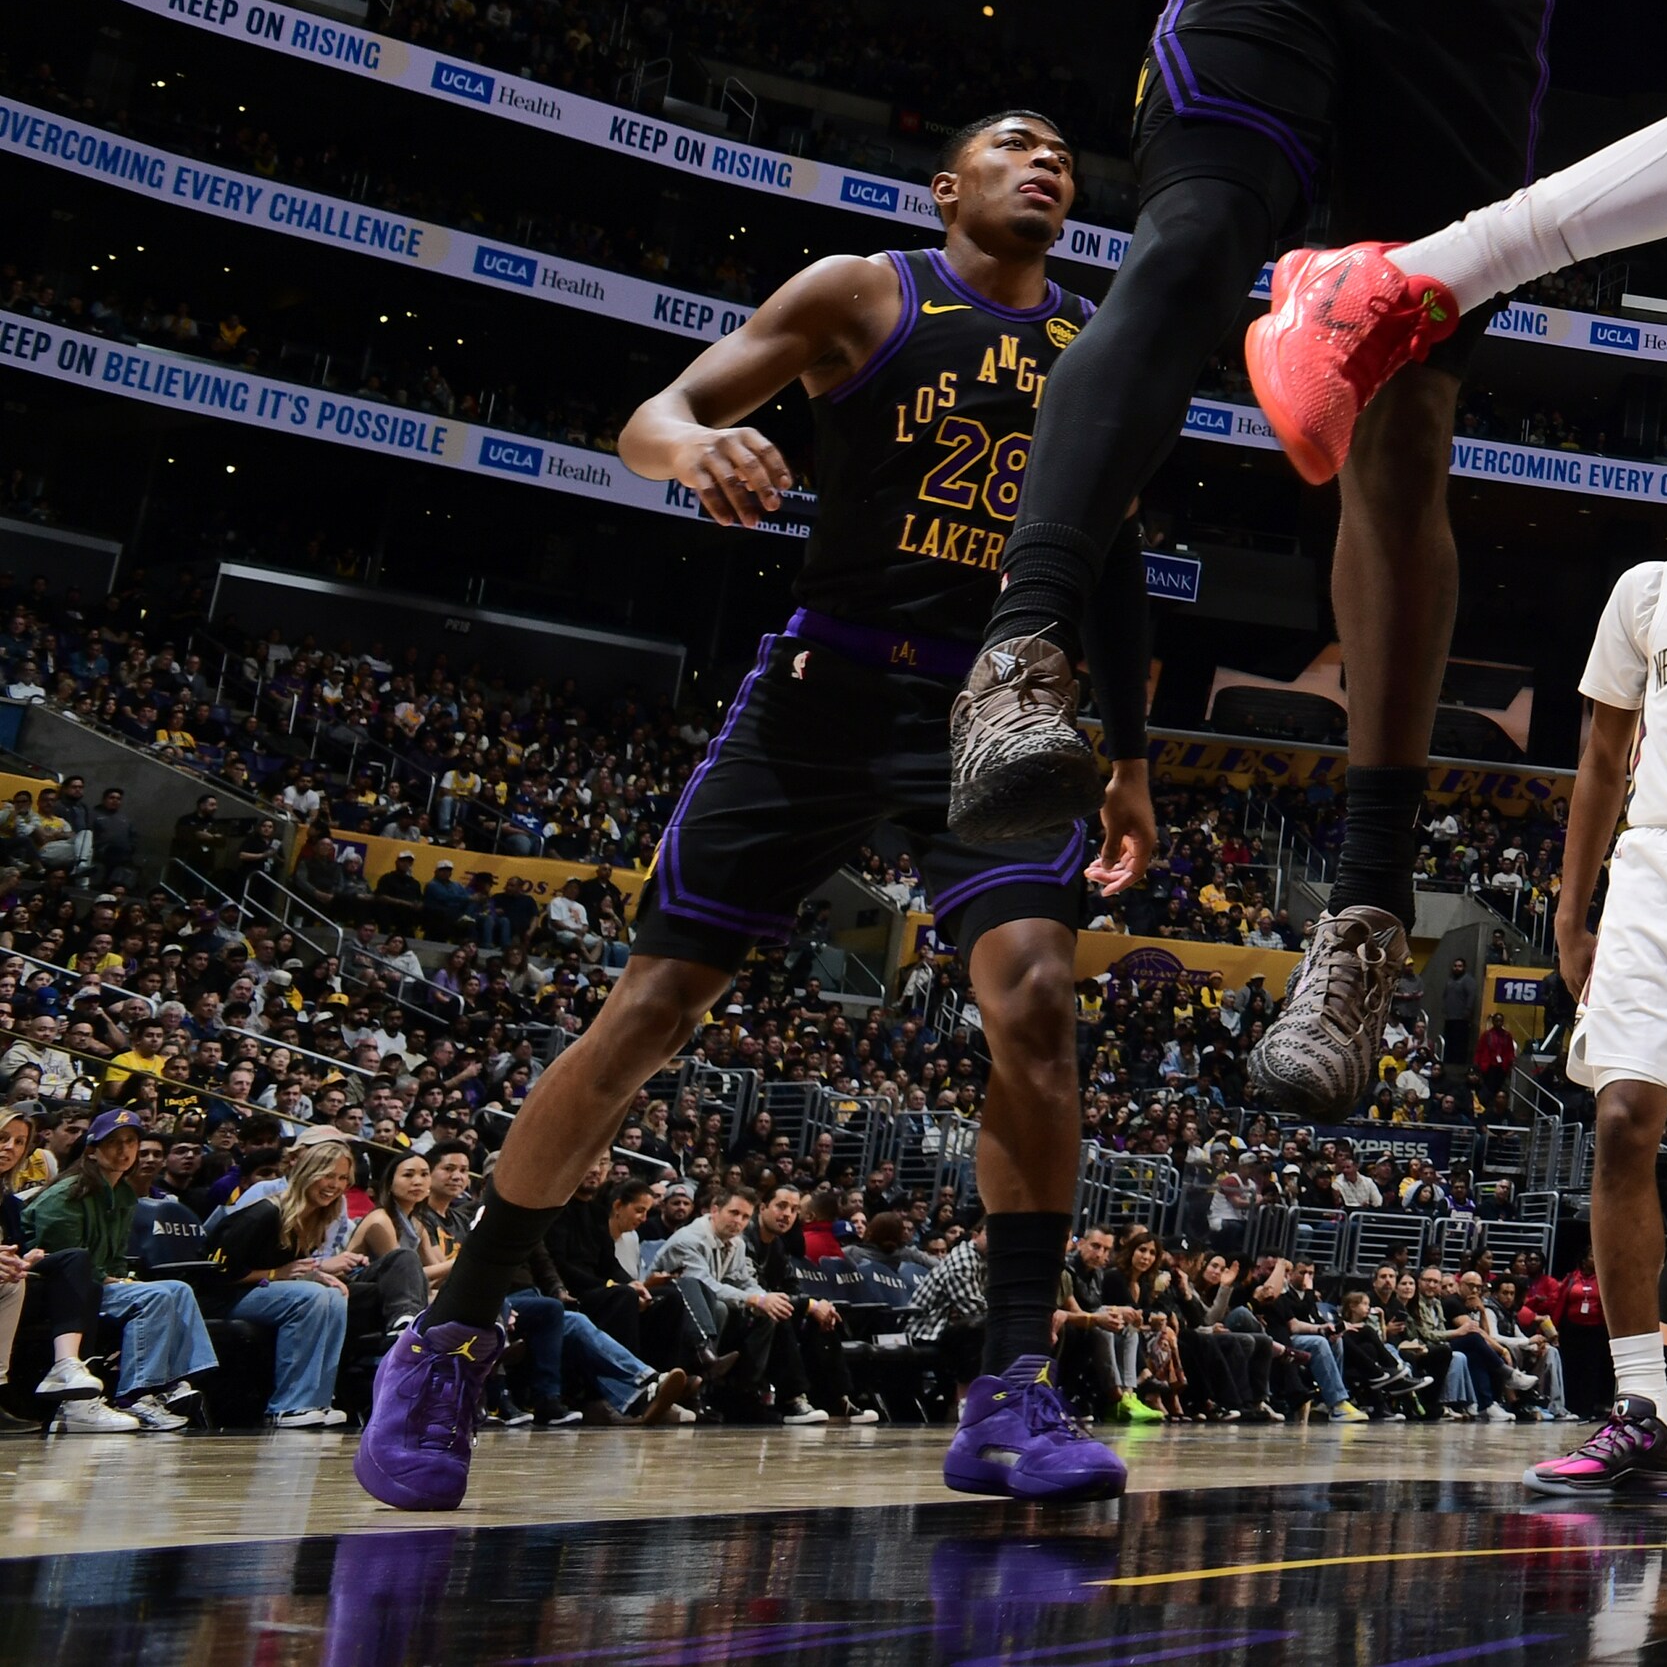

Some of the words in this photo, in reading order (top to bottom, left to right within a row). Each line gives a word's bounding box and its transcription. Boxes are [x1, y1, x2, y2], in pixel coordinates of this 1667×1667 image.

[245, 8, 285, 41] ON
[290, 18, 382, 71] RISING
[172, 168, 262, 218] EVERY
[269, 193, 423, 258] CHALLENGE
[57, 342, 97, 375] ON
[103, 353, 248, 413] BELIEVING
[256, 388, 307, 425] IT'S
[317, 402, 447, 456] POSSIBLE
[896, 372, 958, 442] LOS
[488, 443, 534, 469] UCLA
[547, 456, 612, 489] Health
[918, 415, 1033, 522] 28
[898, 514, 1004, 570] LAKER
[1146, 567, 1192, 591] BANK
[1504, 981, 1536, 1001] 115
[1352, 1139, 1428, 1157] XPRESS
[166, 1222, 206, 1237] DELTA
